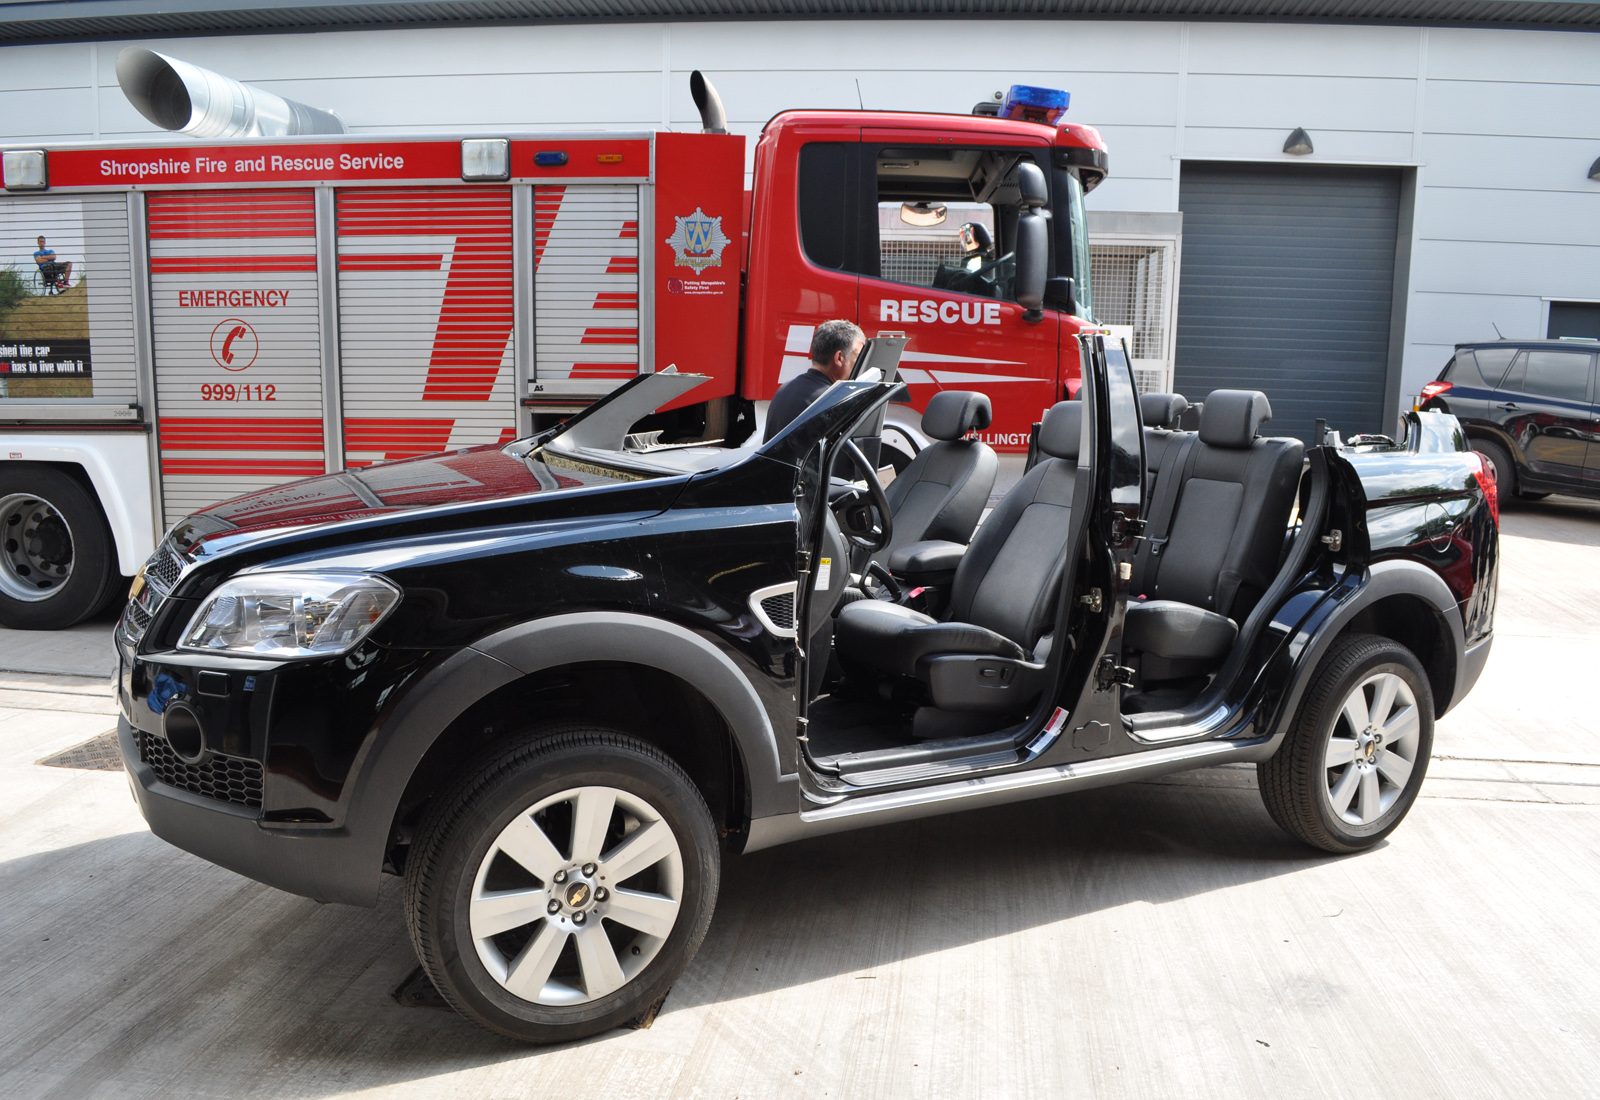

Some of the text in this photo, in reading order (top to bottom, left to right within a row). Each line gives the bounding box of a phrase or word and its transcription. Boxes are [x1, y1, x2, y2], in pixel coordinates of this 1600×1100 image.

[100, 153, 404, 179] Shropshire Fire and Rescue Service
[178, 290, 289, 307] EMERGENCY
[880, 299, 1001, 325] RESCUE
[19, 344, 33, 357] the
[34, 346, 50, 357] car
[11, 360, 27, 373] has
[28, 360, 38, 373] to
[39, 360, 55, 373] live
[56, 360, 75, 373] with
[77, 360, 84, 373] it
[200, 383, 277, 403] 999/112
[958, 433, 1032, 445] ELLINGT
